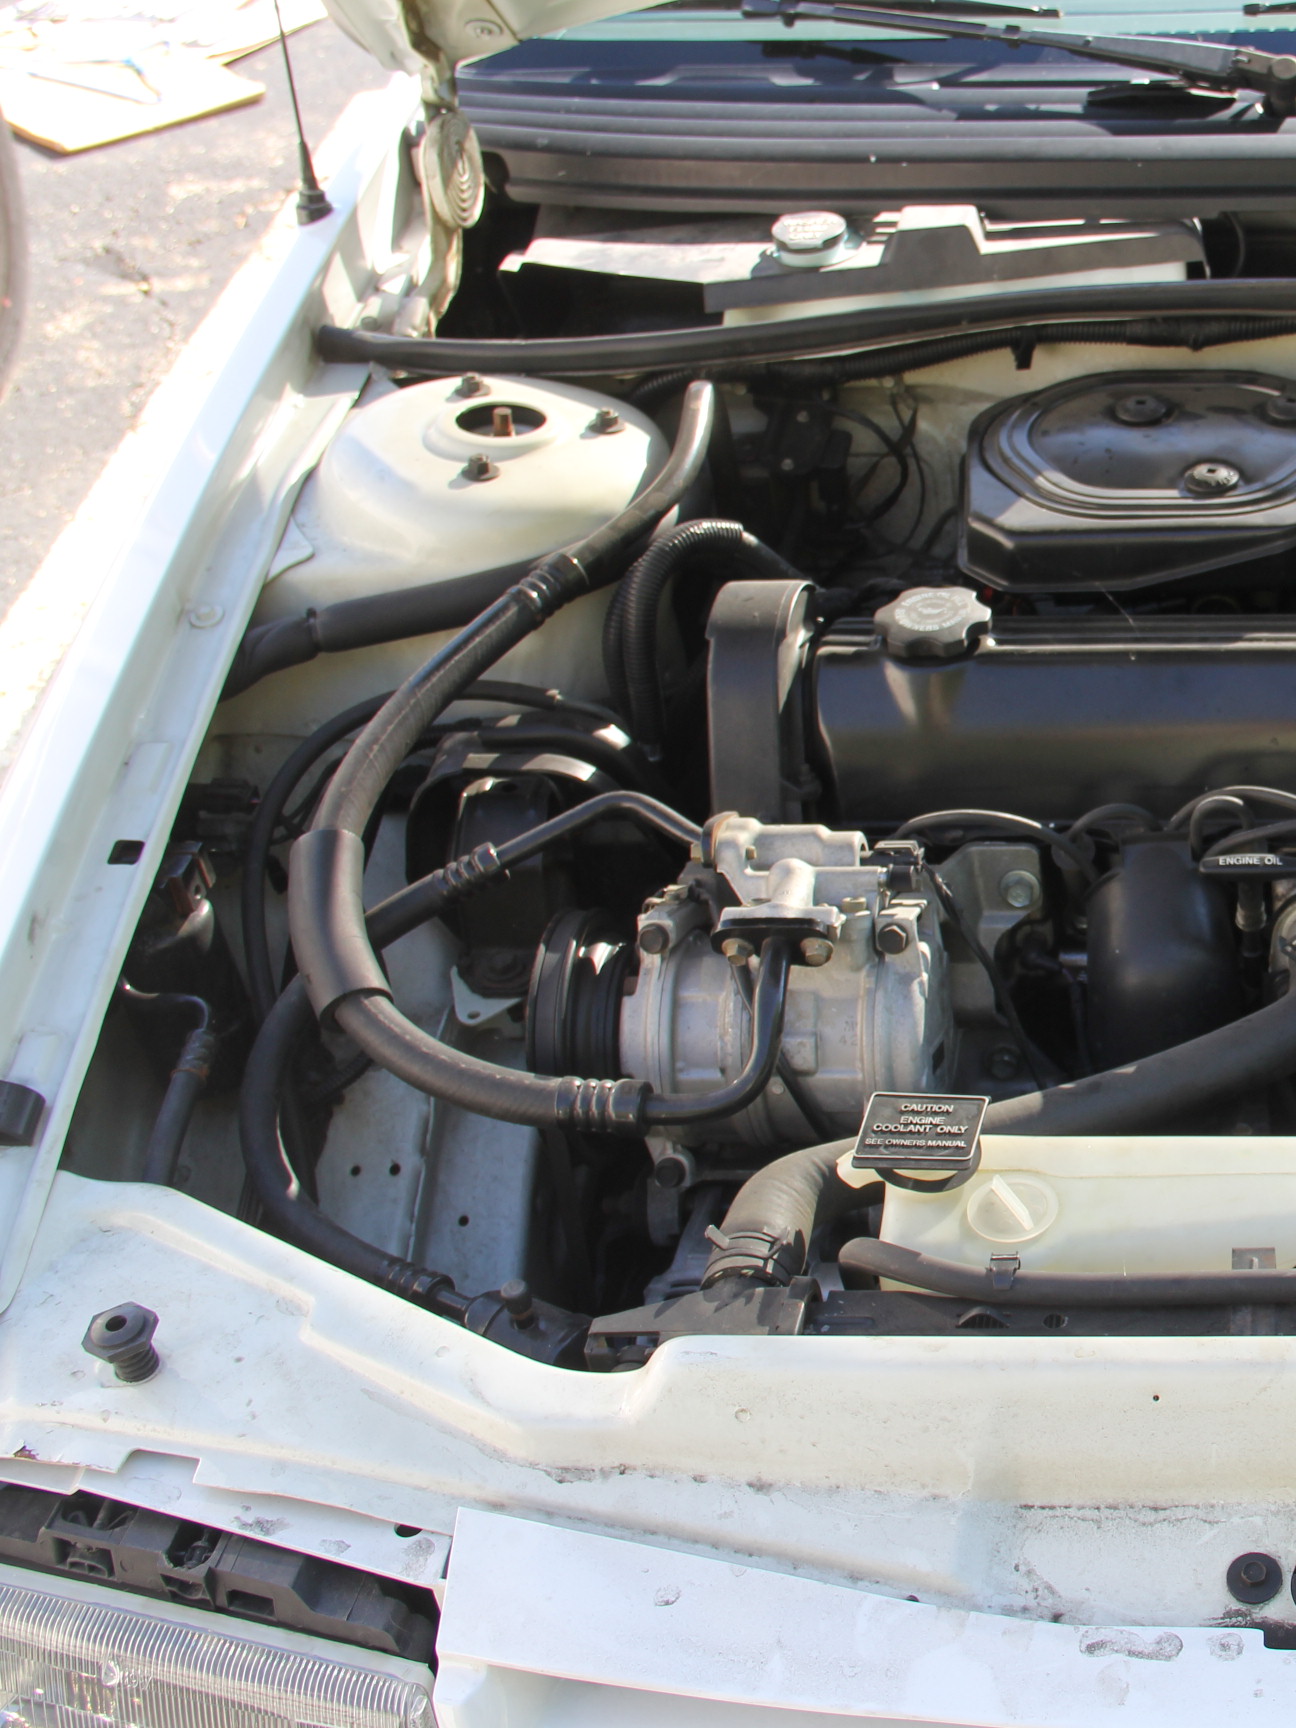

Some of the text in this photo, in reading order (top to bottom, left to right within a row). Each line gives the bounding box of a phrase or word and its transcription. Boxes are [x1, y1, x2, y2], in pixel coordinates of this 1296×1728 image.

[1219, 856, 1283, 866] ENGINE OIL
[901, 1103, 954, 1113] CAUTION
[900, 1115, 946, 1125] ENGINE
[873, 1123, 969, 1134] COOLANT ONLY
[865, 1137, 967, 1148] SEE OWNERS MANUAL
